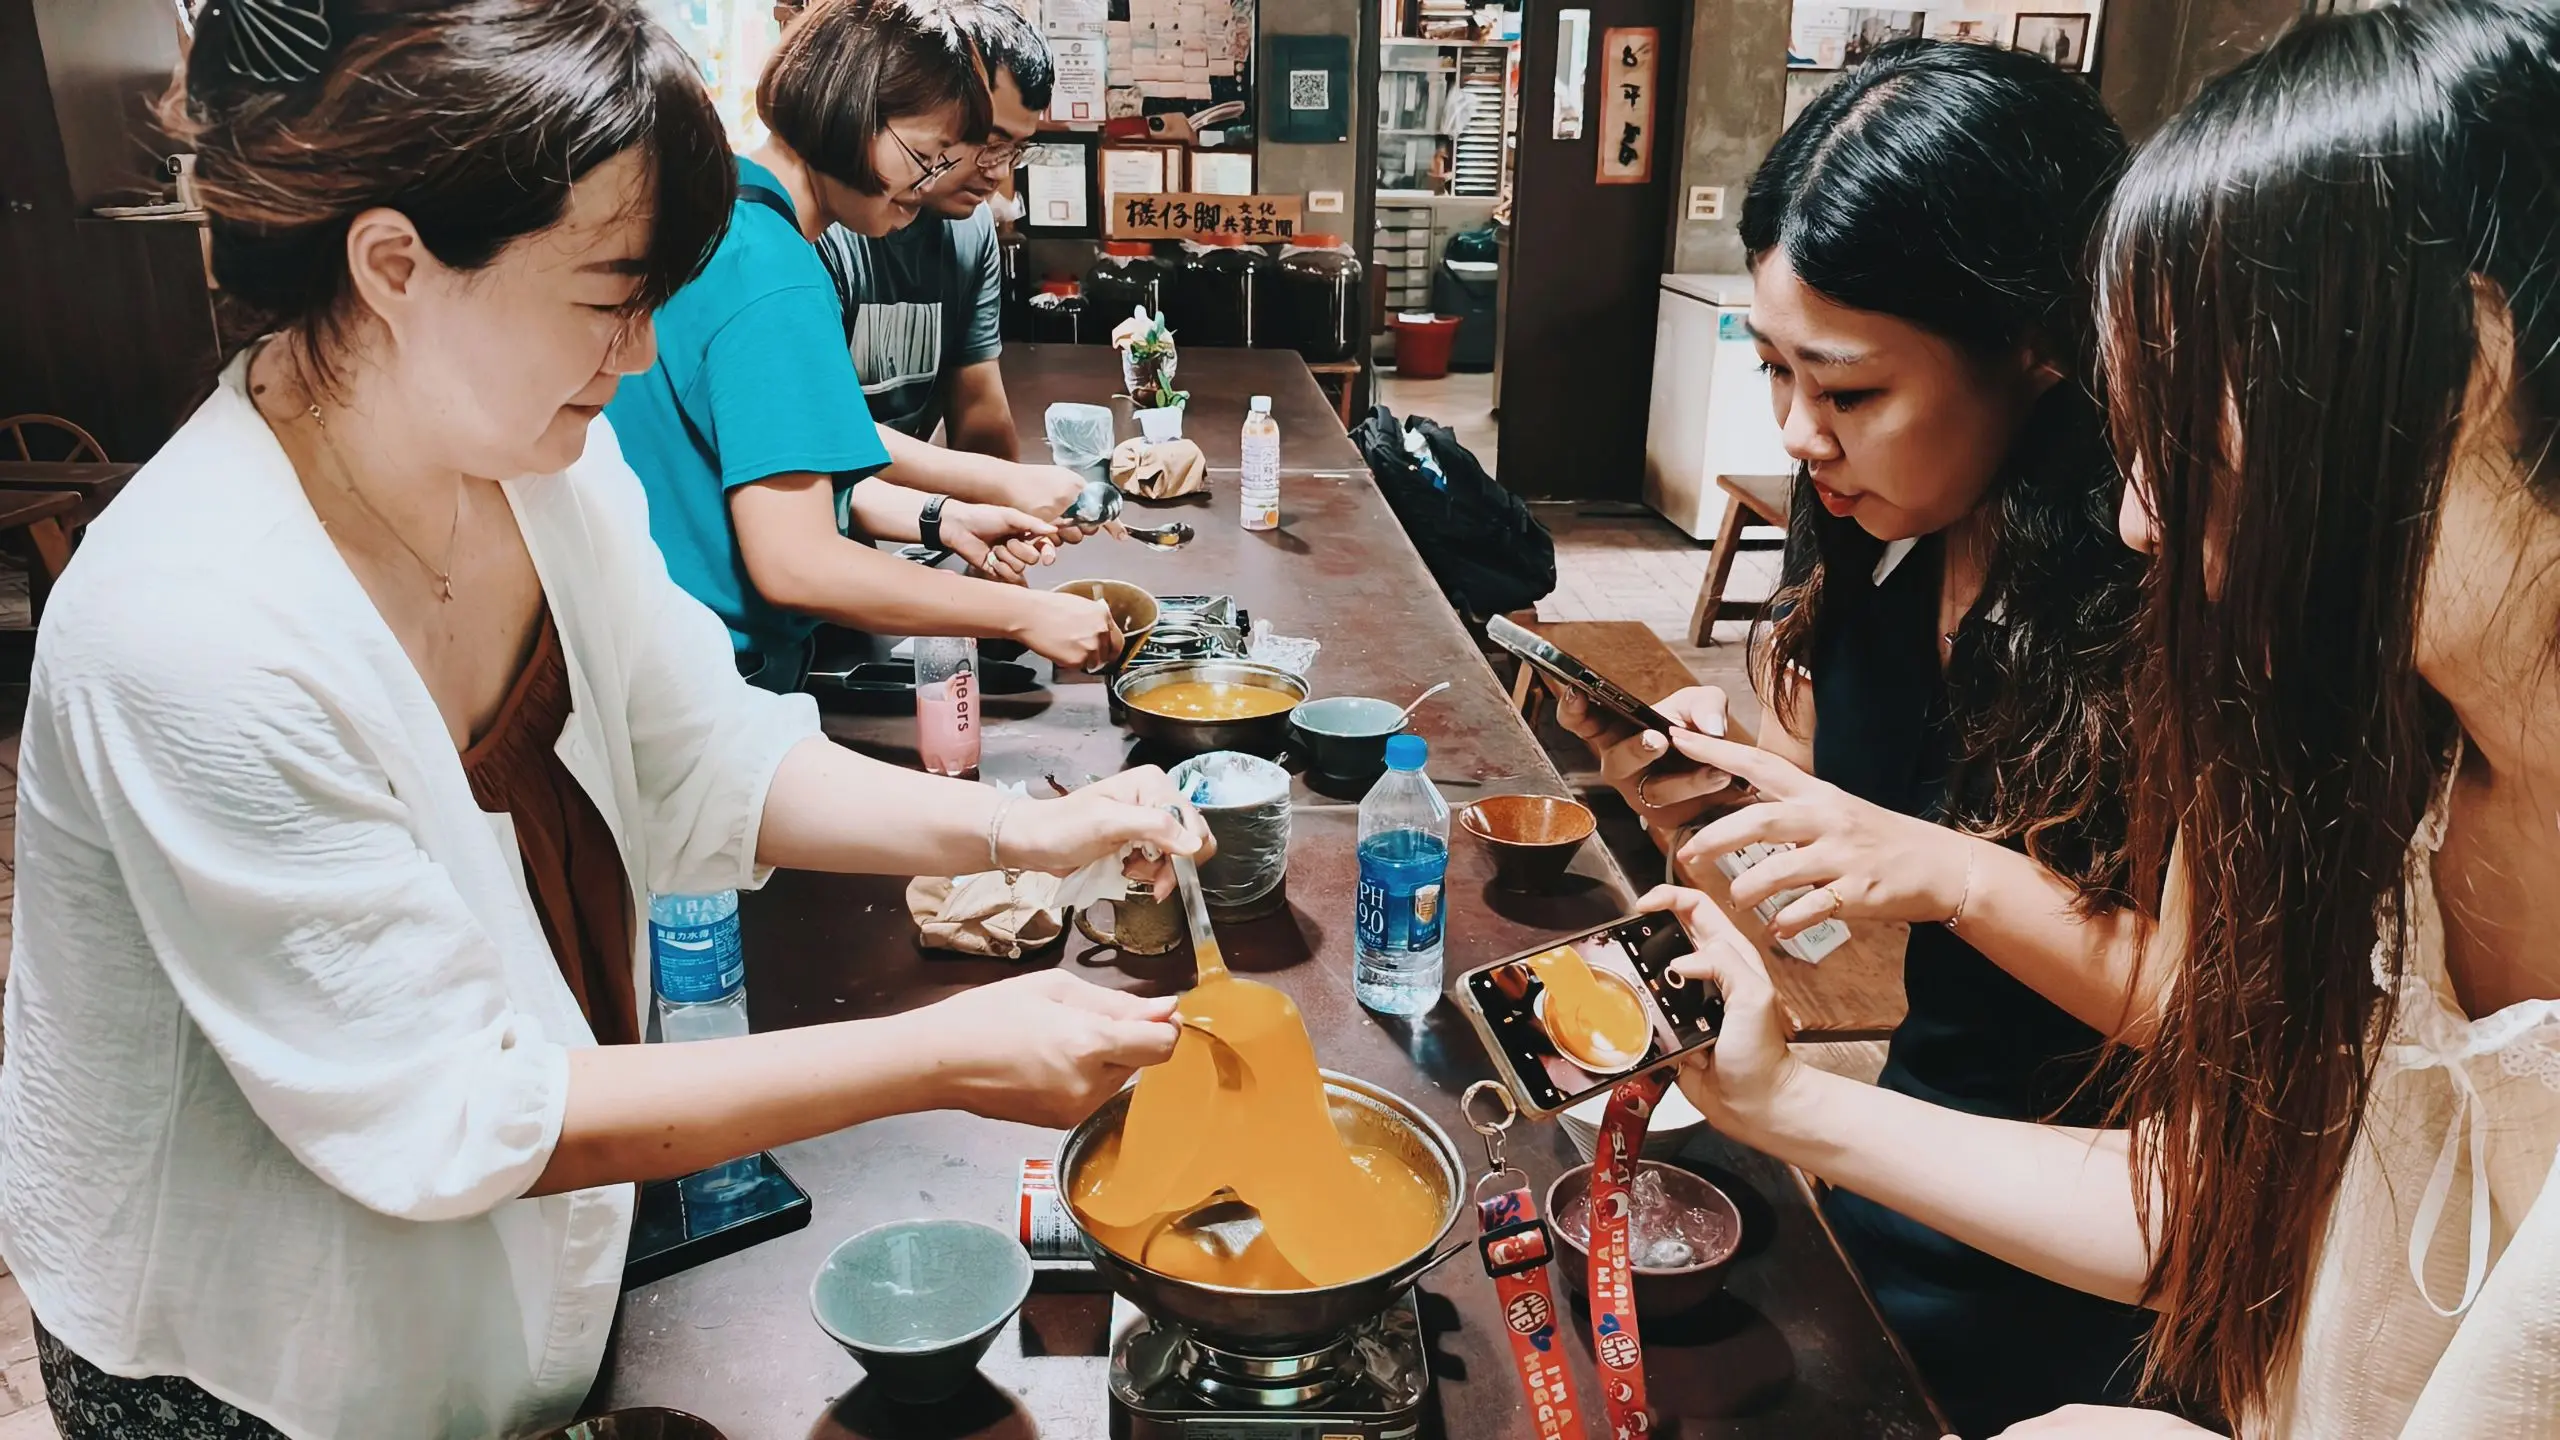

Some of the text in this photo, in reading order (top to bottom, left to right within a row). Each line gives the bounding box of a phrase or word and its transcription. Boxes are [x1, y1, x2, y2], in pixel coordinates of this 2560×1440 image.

[1238, 201, 1276, 216] 文化
[1222, 215, 1293, 238] 共享空間
[955, 658, 972, 732] Cheers
[1360, 881, 1385, 910] PH
[1359, 902, 1384, 934] 9.0
[1597, 1246, 1610, 1261] A
[1611, 1228, 1630, 1315] HUGGER
[1510, 1300, 1535, 1331] ME!
[1525, 1294, 1547, 1324] HUG
[1602, 1338, 1622, 1367] HUG
[1616, 1335, 1638, 1364] ME!
